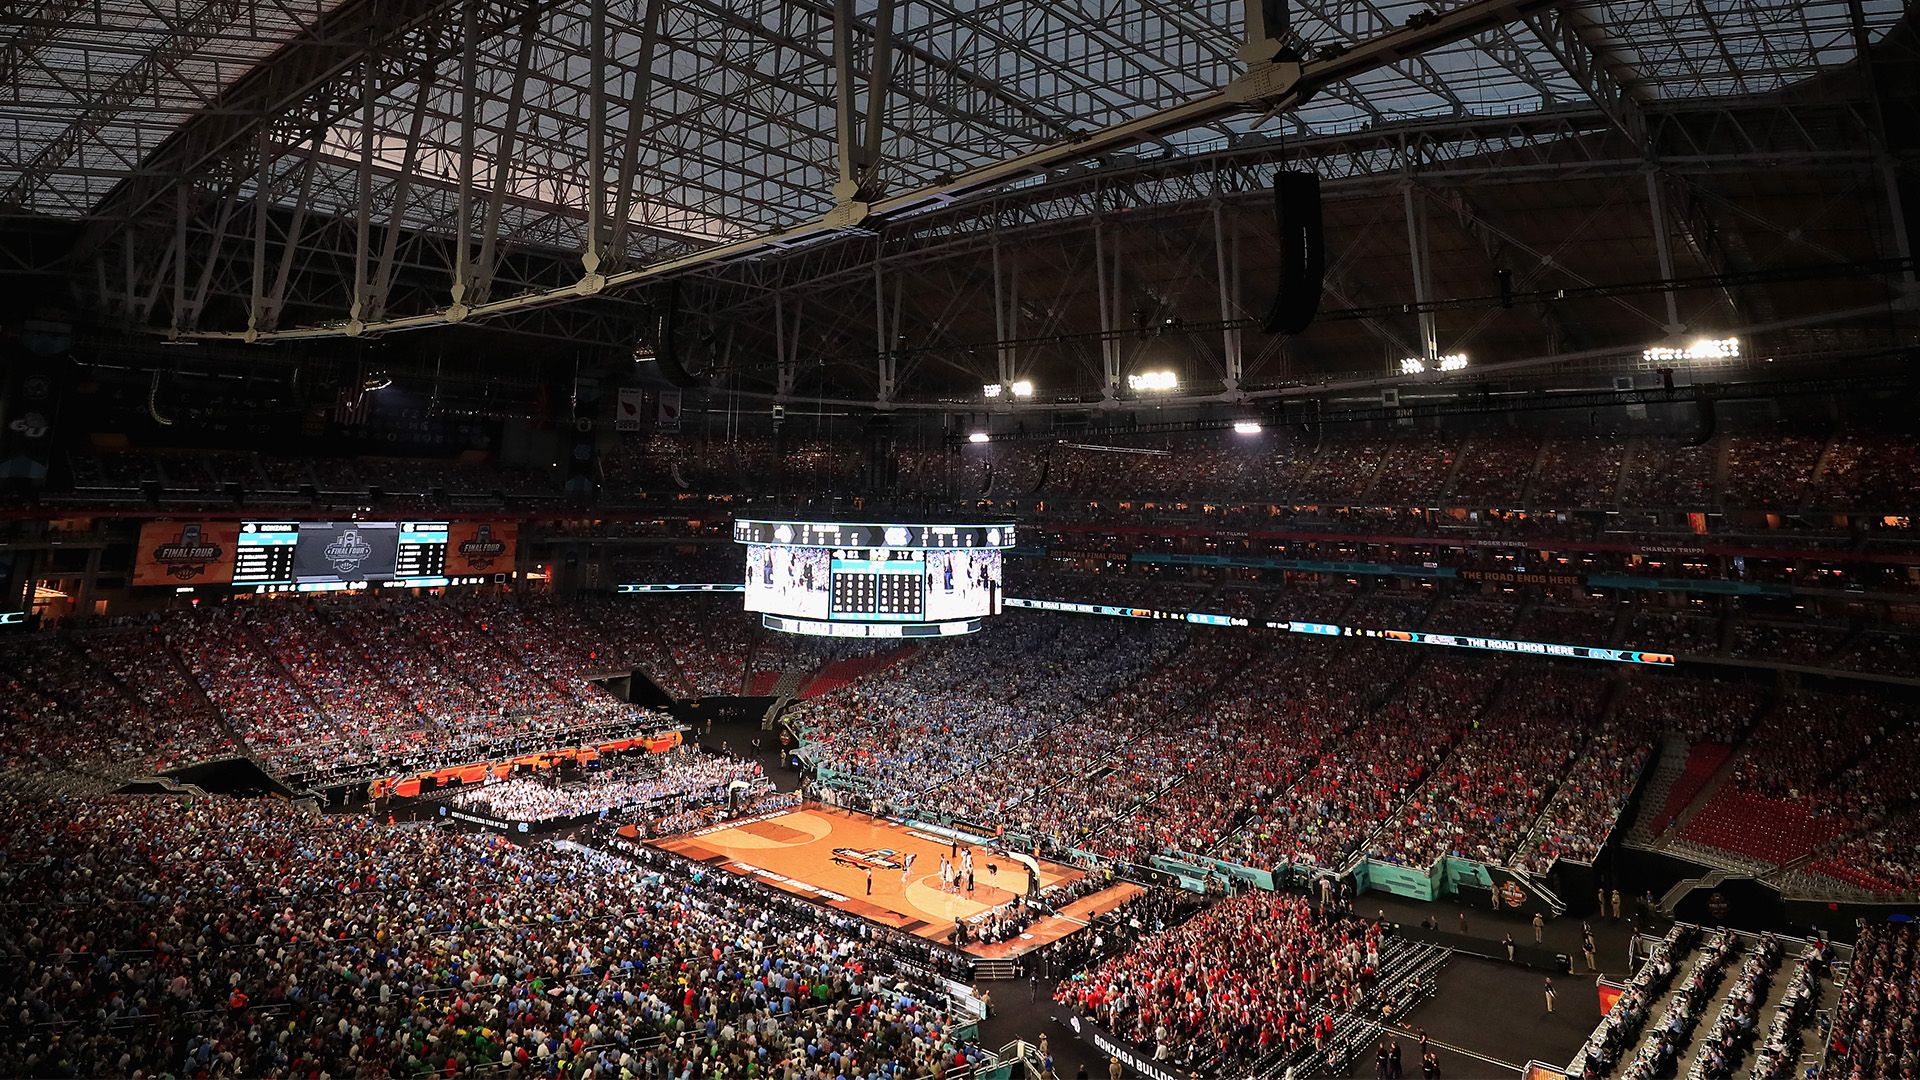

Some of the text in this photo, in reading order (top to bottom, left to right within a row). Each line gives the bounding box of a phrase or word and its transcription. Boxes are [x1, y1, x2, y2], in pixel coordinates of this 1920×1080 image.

[162, 548, 215, 558] FINAL FOUR
[464, 543, 500, 552] FINAL FOUR
[897, 551, 909, 560] 17
[1462, 571, 1579, 585] THE ROAD ENDS HERE
[1356, 628, 1362, 636] 4
[1377, 630, 1383, 638] 4
[1467, 638, 1485, 647] THE
[1488, 639, 1515, 651] ROAD
[1517, 642, 1545, 653] ENDS
[1547, 643, 1574, 655] HERE
[451, 811, 464, 821] NORTH
[464, 814, 485, 825] CAROLINA
[485, 819, 494, 827] TAR
[694, 810, 789, 836] NCAA FINAL FOUR
[733, 863, 851, 902] THE ROAD ENDS HERE
[1094, 1033, 1179, 1080] GONZAGA BULLDO
